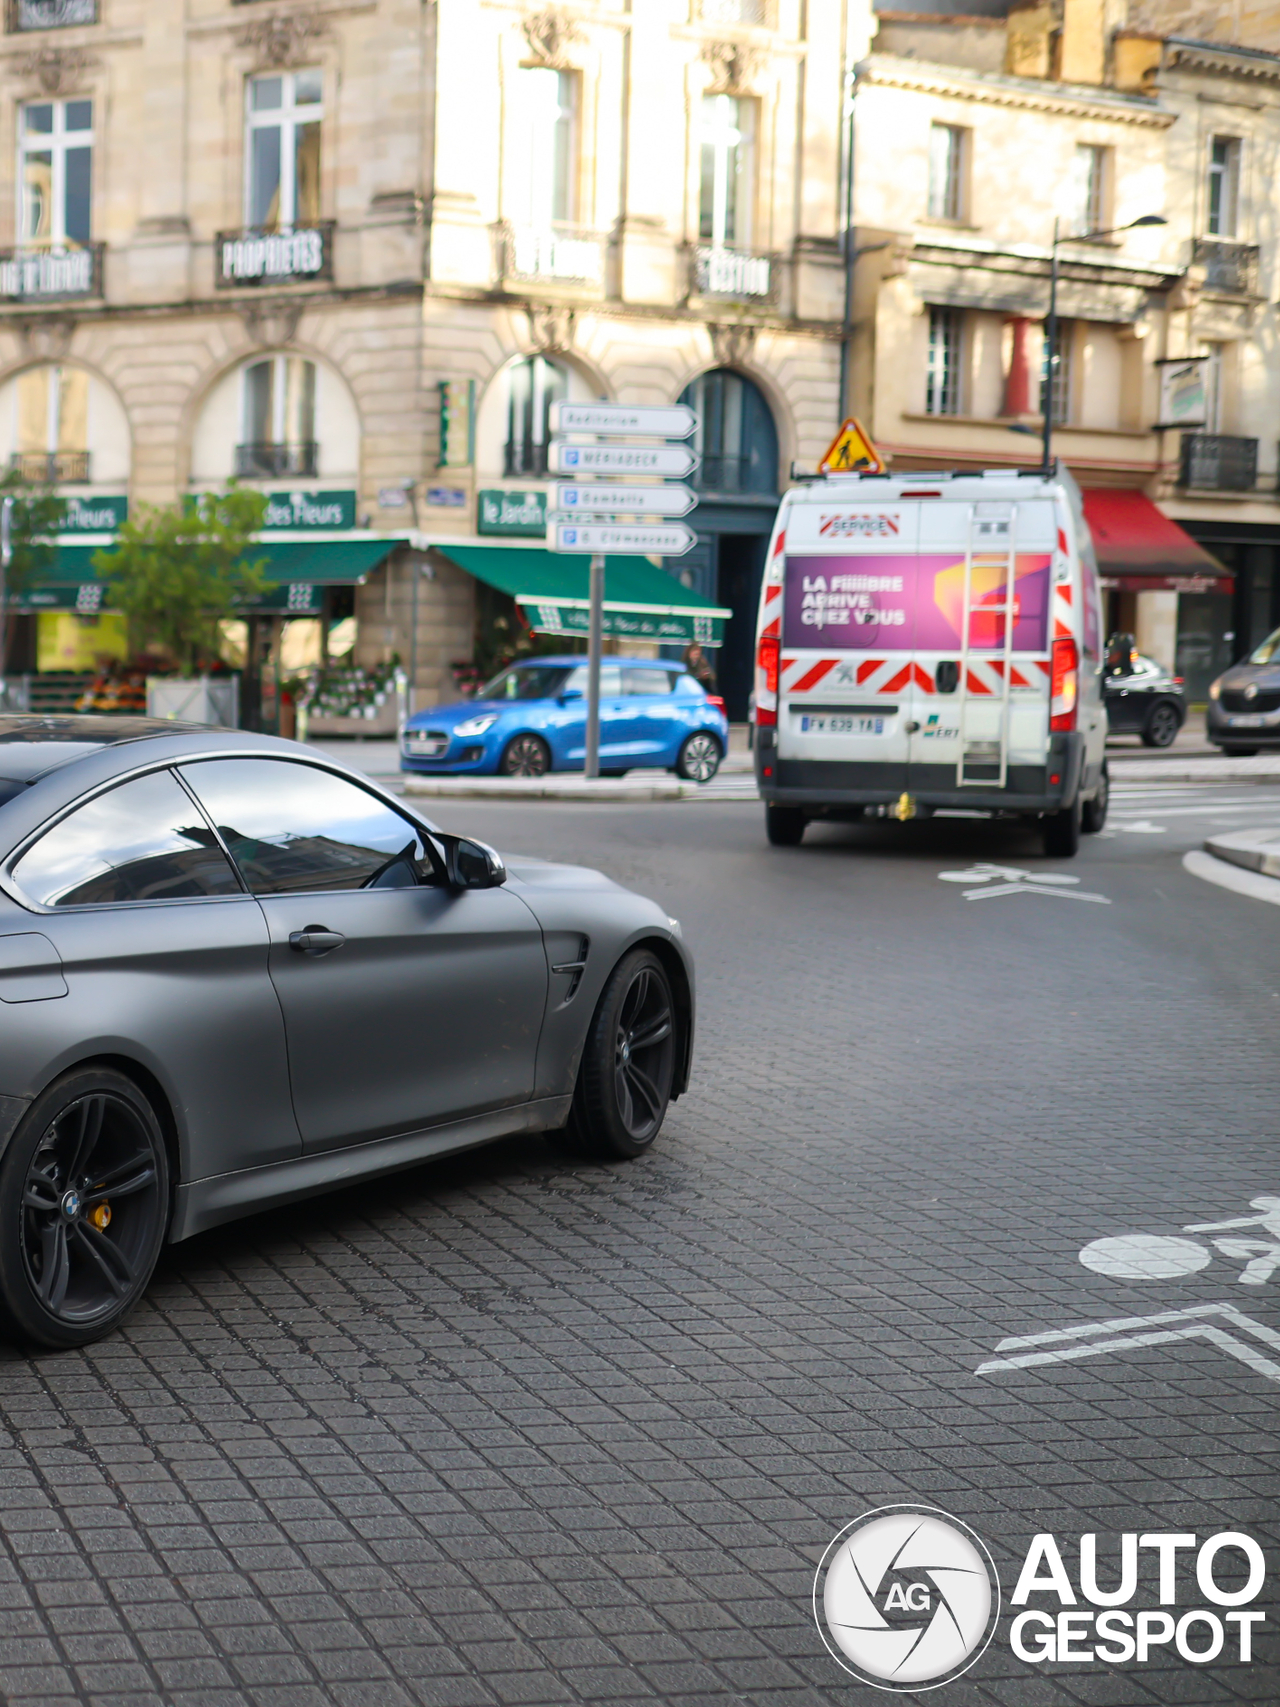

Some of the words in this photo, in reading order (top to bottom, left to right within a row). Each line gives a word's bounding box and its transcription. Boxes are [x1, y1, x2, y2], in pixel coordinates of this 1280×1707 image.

[566, 413, 639, 426] Auditorium
[581, 490, 645, 505] Gambetta
[294, 498, 343, 526] Fleurs
[500, 498, 543, 525] Jardin
[833, 519, 887, 531] SERVICE
[802, 575, 827, 592] LA
